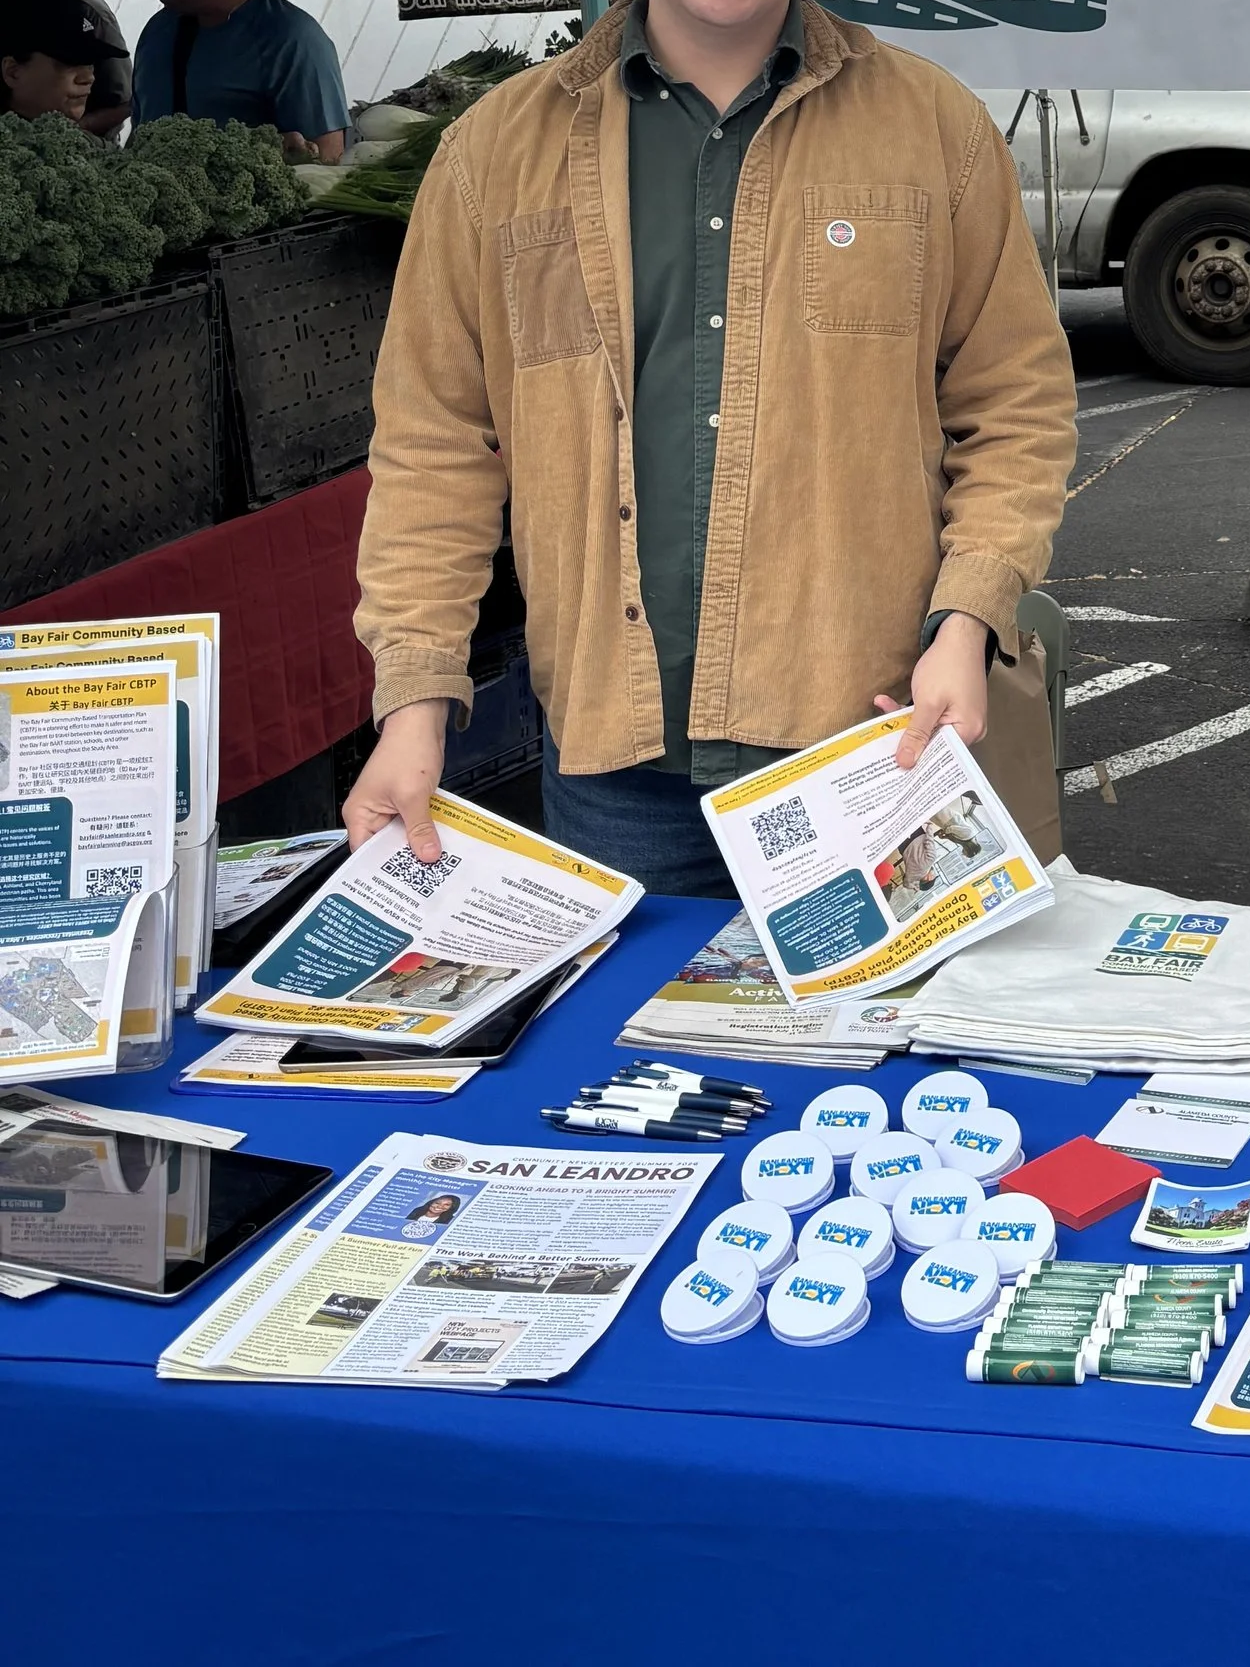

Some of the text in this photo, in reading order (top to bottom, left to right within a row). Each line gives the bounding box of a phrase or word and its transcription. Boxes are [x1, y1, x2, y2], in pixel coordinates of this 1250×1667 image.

[21, 624, 185, 644] Bay Fair Community Based
[26, 679, 157, 697] About the Bay Fair CBTP
[73, 701, 89, 710] Bay
[92, 699, 108, 708] Fair
[111, 697, 134, 707] CBTP
[1105, 954, 1204, 969] BAY FAIR
[467, 1160, 537, 1178] SAN
[543, 1165, 695, 1181] LEANDRO
[436, 1248, 456, 1256] The
[458, 1250, 486, 1258] Work
[489, 1252, 526, 1261] Behind
[539, 1254, 572, 1262] Better
